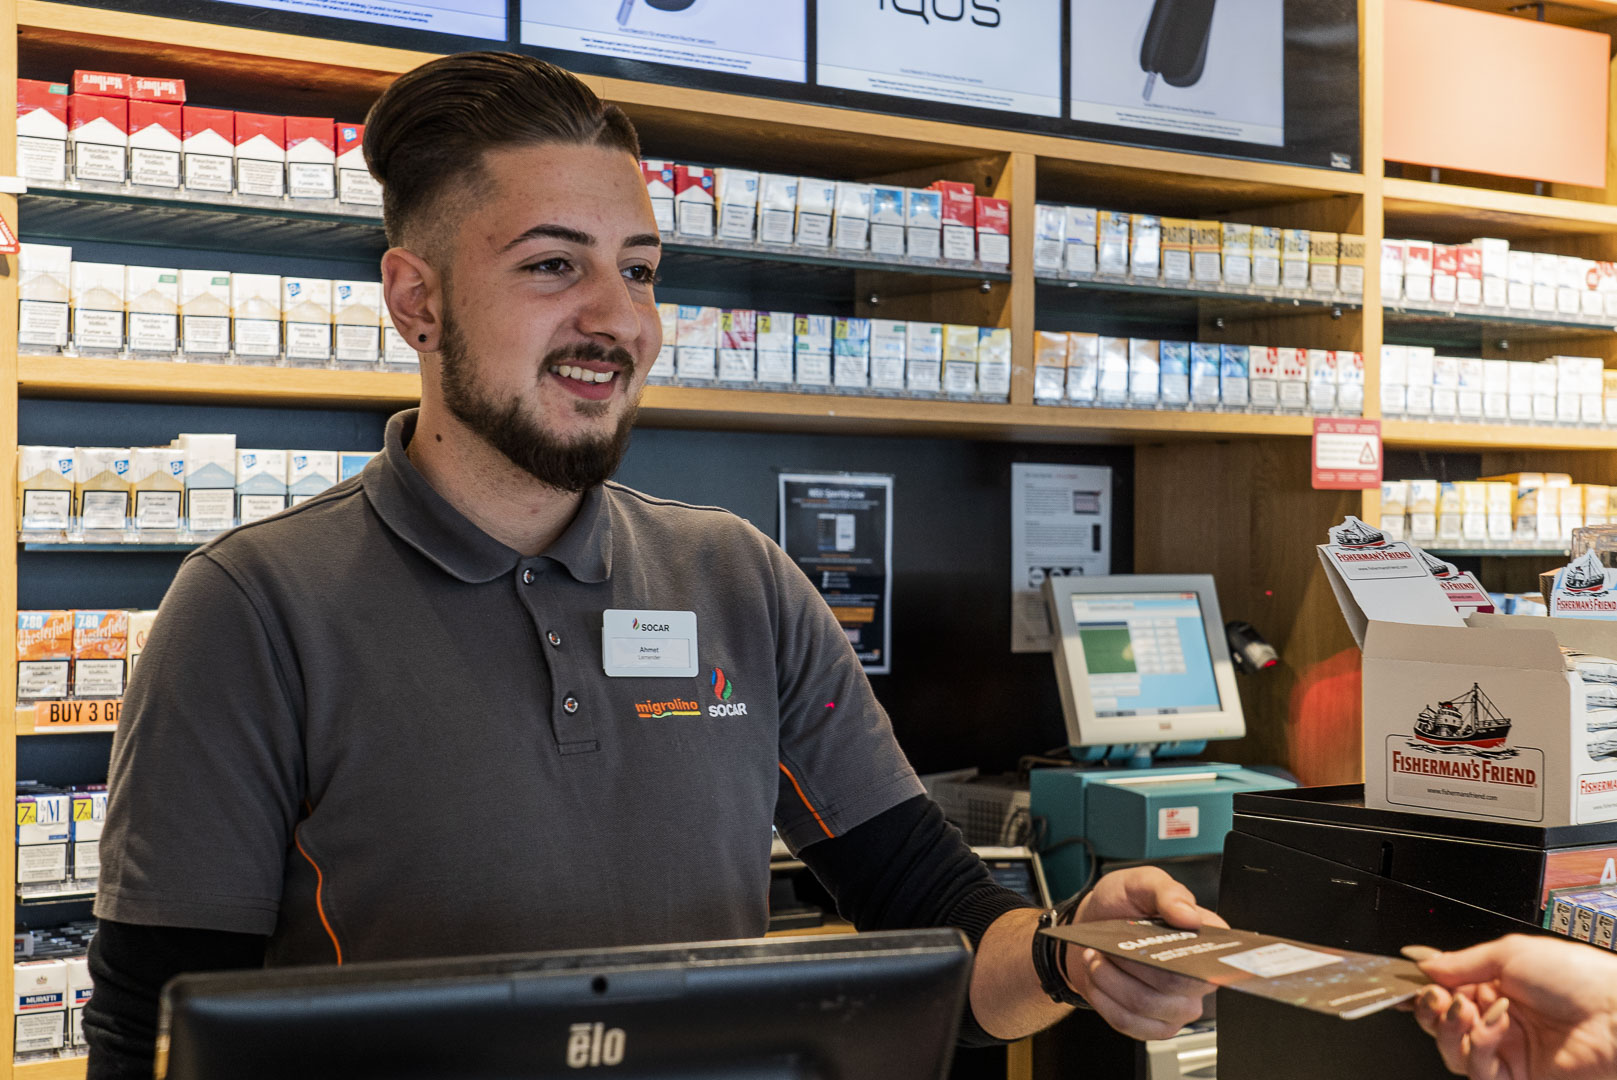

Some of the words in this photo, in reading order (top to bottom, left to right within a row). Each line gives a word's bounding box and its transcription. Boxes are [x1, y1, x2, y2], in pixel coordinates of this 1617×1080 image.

[880, 0, 1001, 28] QOS
[1335, 552, 1385, 563] FISHERMAN'S
[1383, 551, 1413, 561] FRIEND
[1557, 597, 1593, 611] FISHERMAN'S
[1593, 598, 1617, 610] FRIEND
[641, 623, 670, 632] SOCAR
[50, 703, 83, 723] BUY
[89, 703, 98, 722] 3
[104, 702, 122, 721] GE
[635, 698, 699, 714] migrolino
[708, 702, 748, 718] SOCAR
[1392, 751, 1481, 781] FISHERMAN'S
[1481, 760, 1536, 786] FRIEND
[1427, 787, 1498, 802] www.fishermansfriend.com
[1580, 780, 1617, 794] FISHERMA
